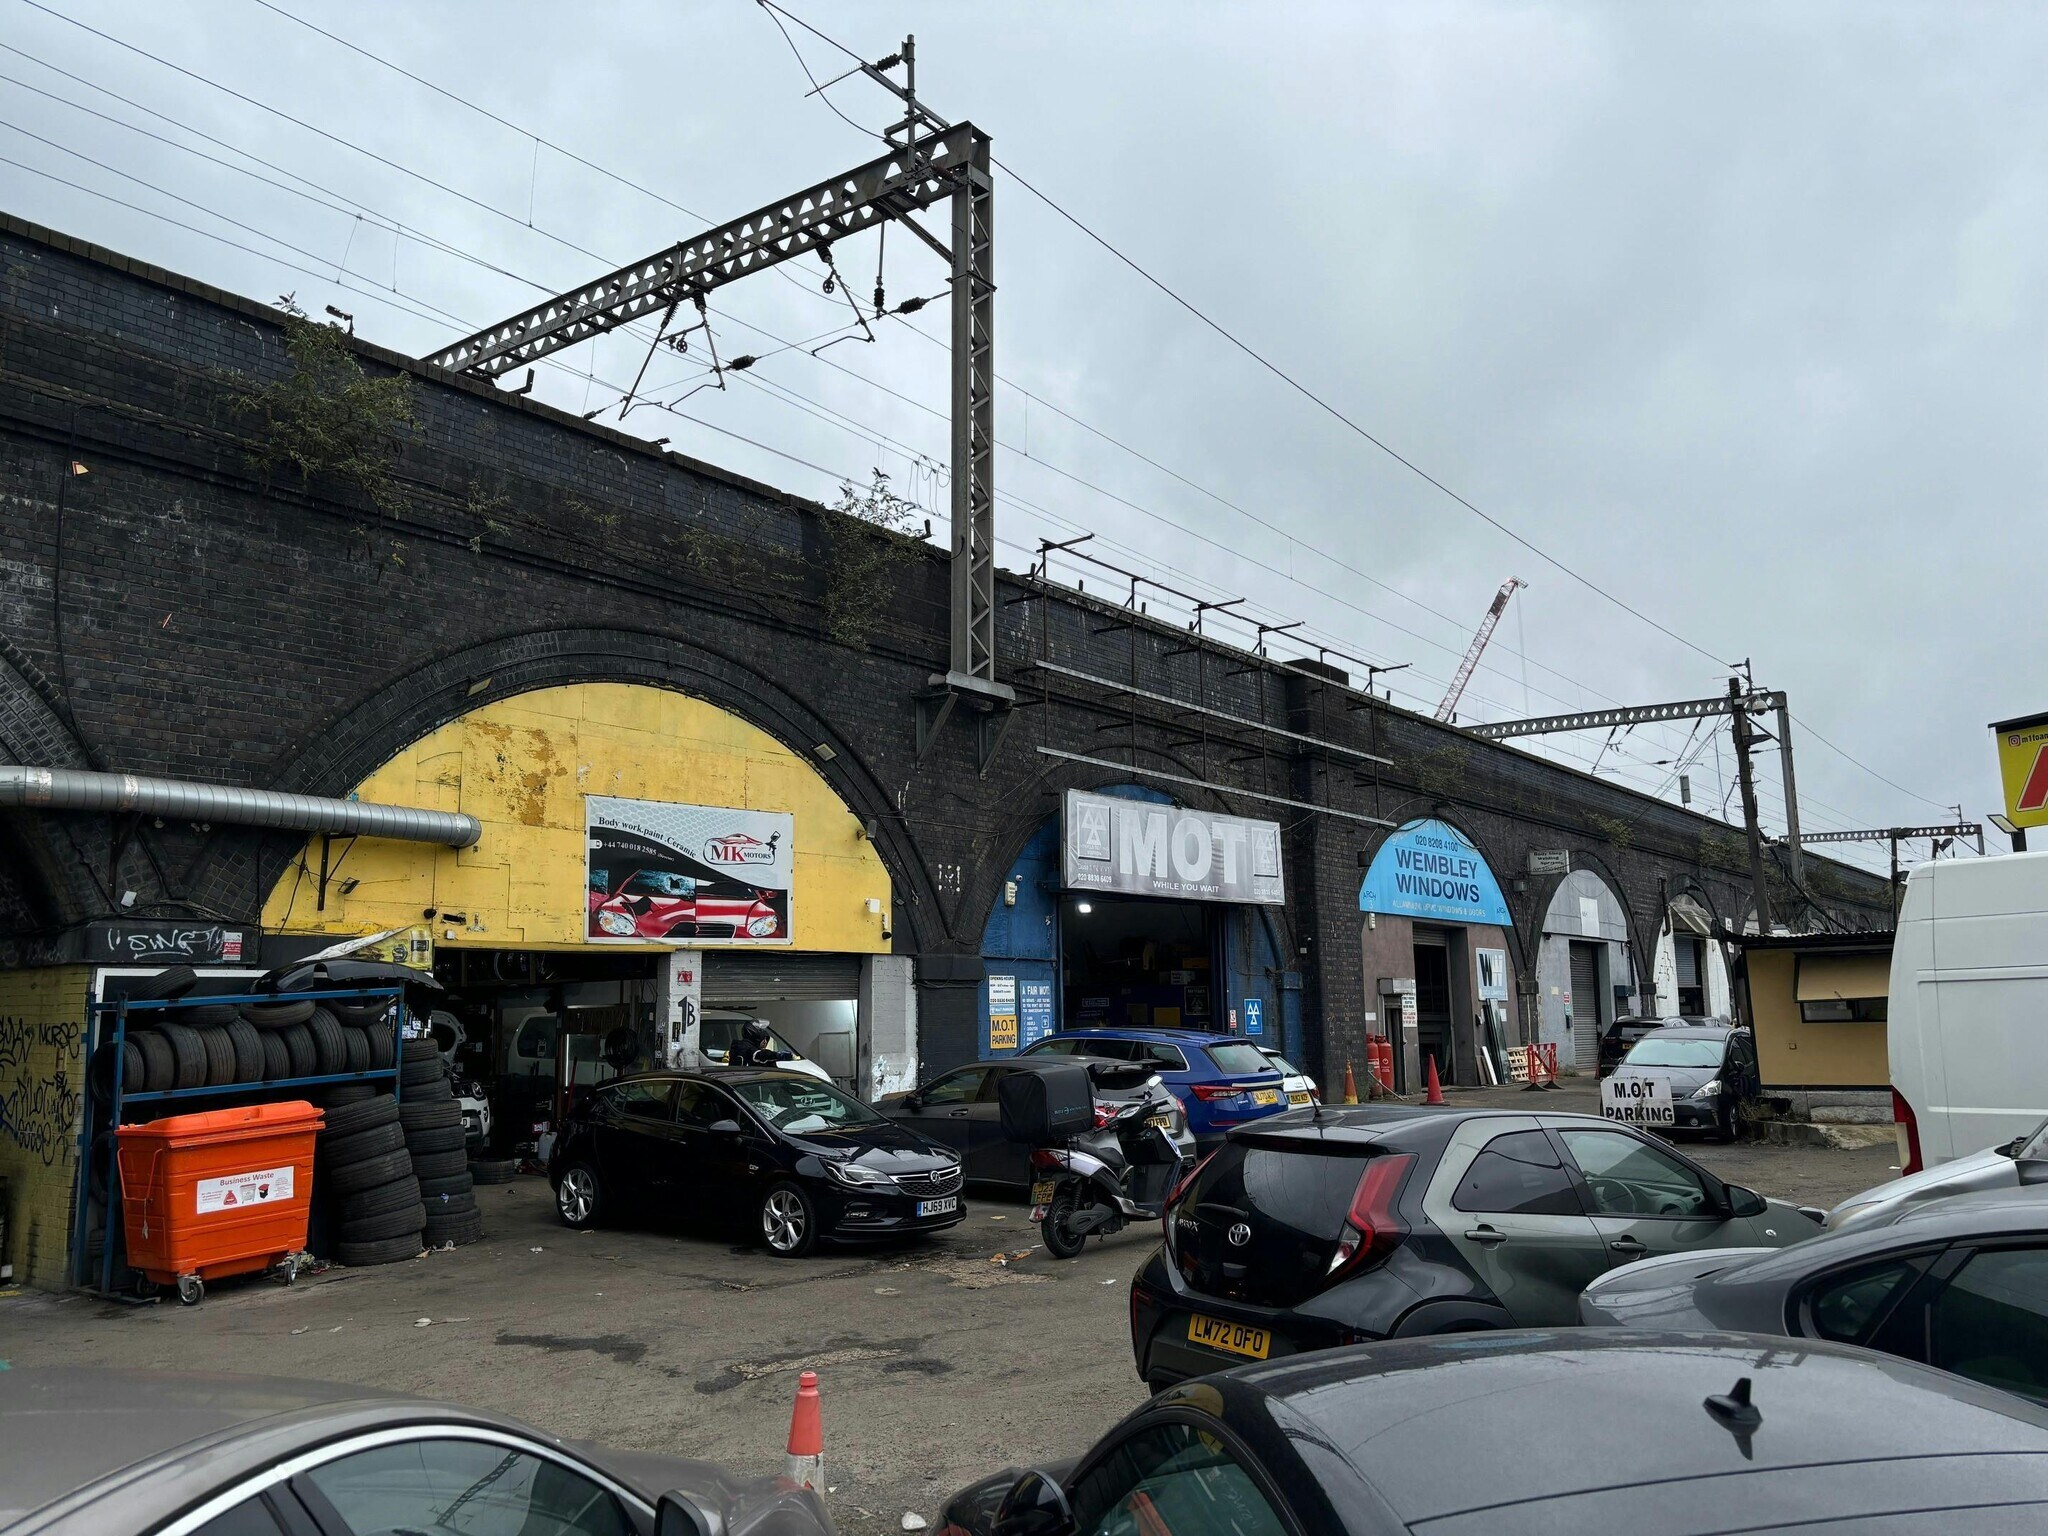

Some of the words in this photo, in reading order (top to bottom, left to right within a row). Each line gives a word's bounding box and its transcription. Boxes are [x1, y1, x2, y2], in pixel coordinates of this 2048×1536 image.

[598, 816, 622, 828] Body
[617, 842, 629, 850] 740
[629, 843, 641, 851] 018
[1120, 808, 1246, 884] MOT
[1415, 835, 1427, 846] 020
[1428, 836, 1443, 848] 8208
[1444, 840, 1458, 852] 4100
[711, 845, 746, 862] MK
[1395, 847, 1478, 879] WEMBLEY
[1152, 880, 1180, 890] WHILE
[1181, 882, 1199, 892] YOU
[1199, 884, 1220, 893] WAIT
[1395, 873, 1480, 903] WINDOWS
[1027, 985, 1038, 995] FAIR
[992, 1020, 1015, 1031] M.O.T
[992, 1034, 1016, 1045] PARKING
[1614, 1082, 1655, 1098] M.O.T
[1605, 1106, 1673, 1122] PARKING
[220, 1175, 251, 1187] Business
[252, 1172, 275, 1181] Waste
[922, 1200, 943, 1214] HJ69
[943, 1197, 956, 1211] XVC
[1194, 1317, 1231, 1345] LM72
